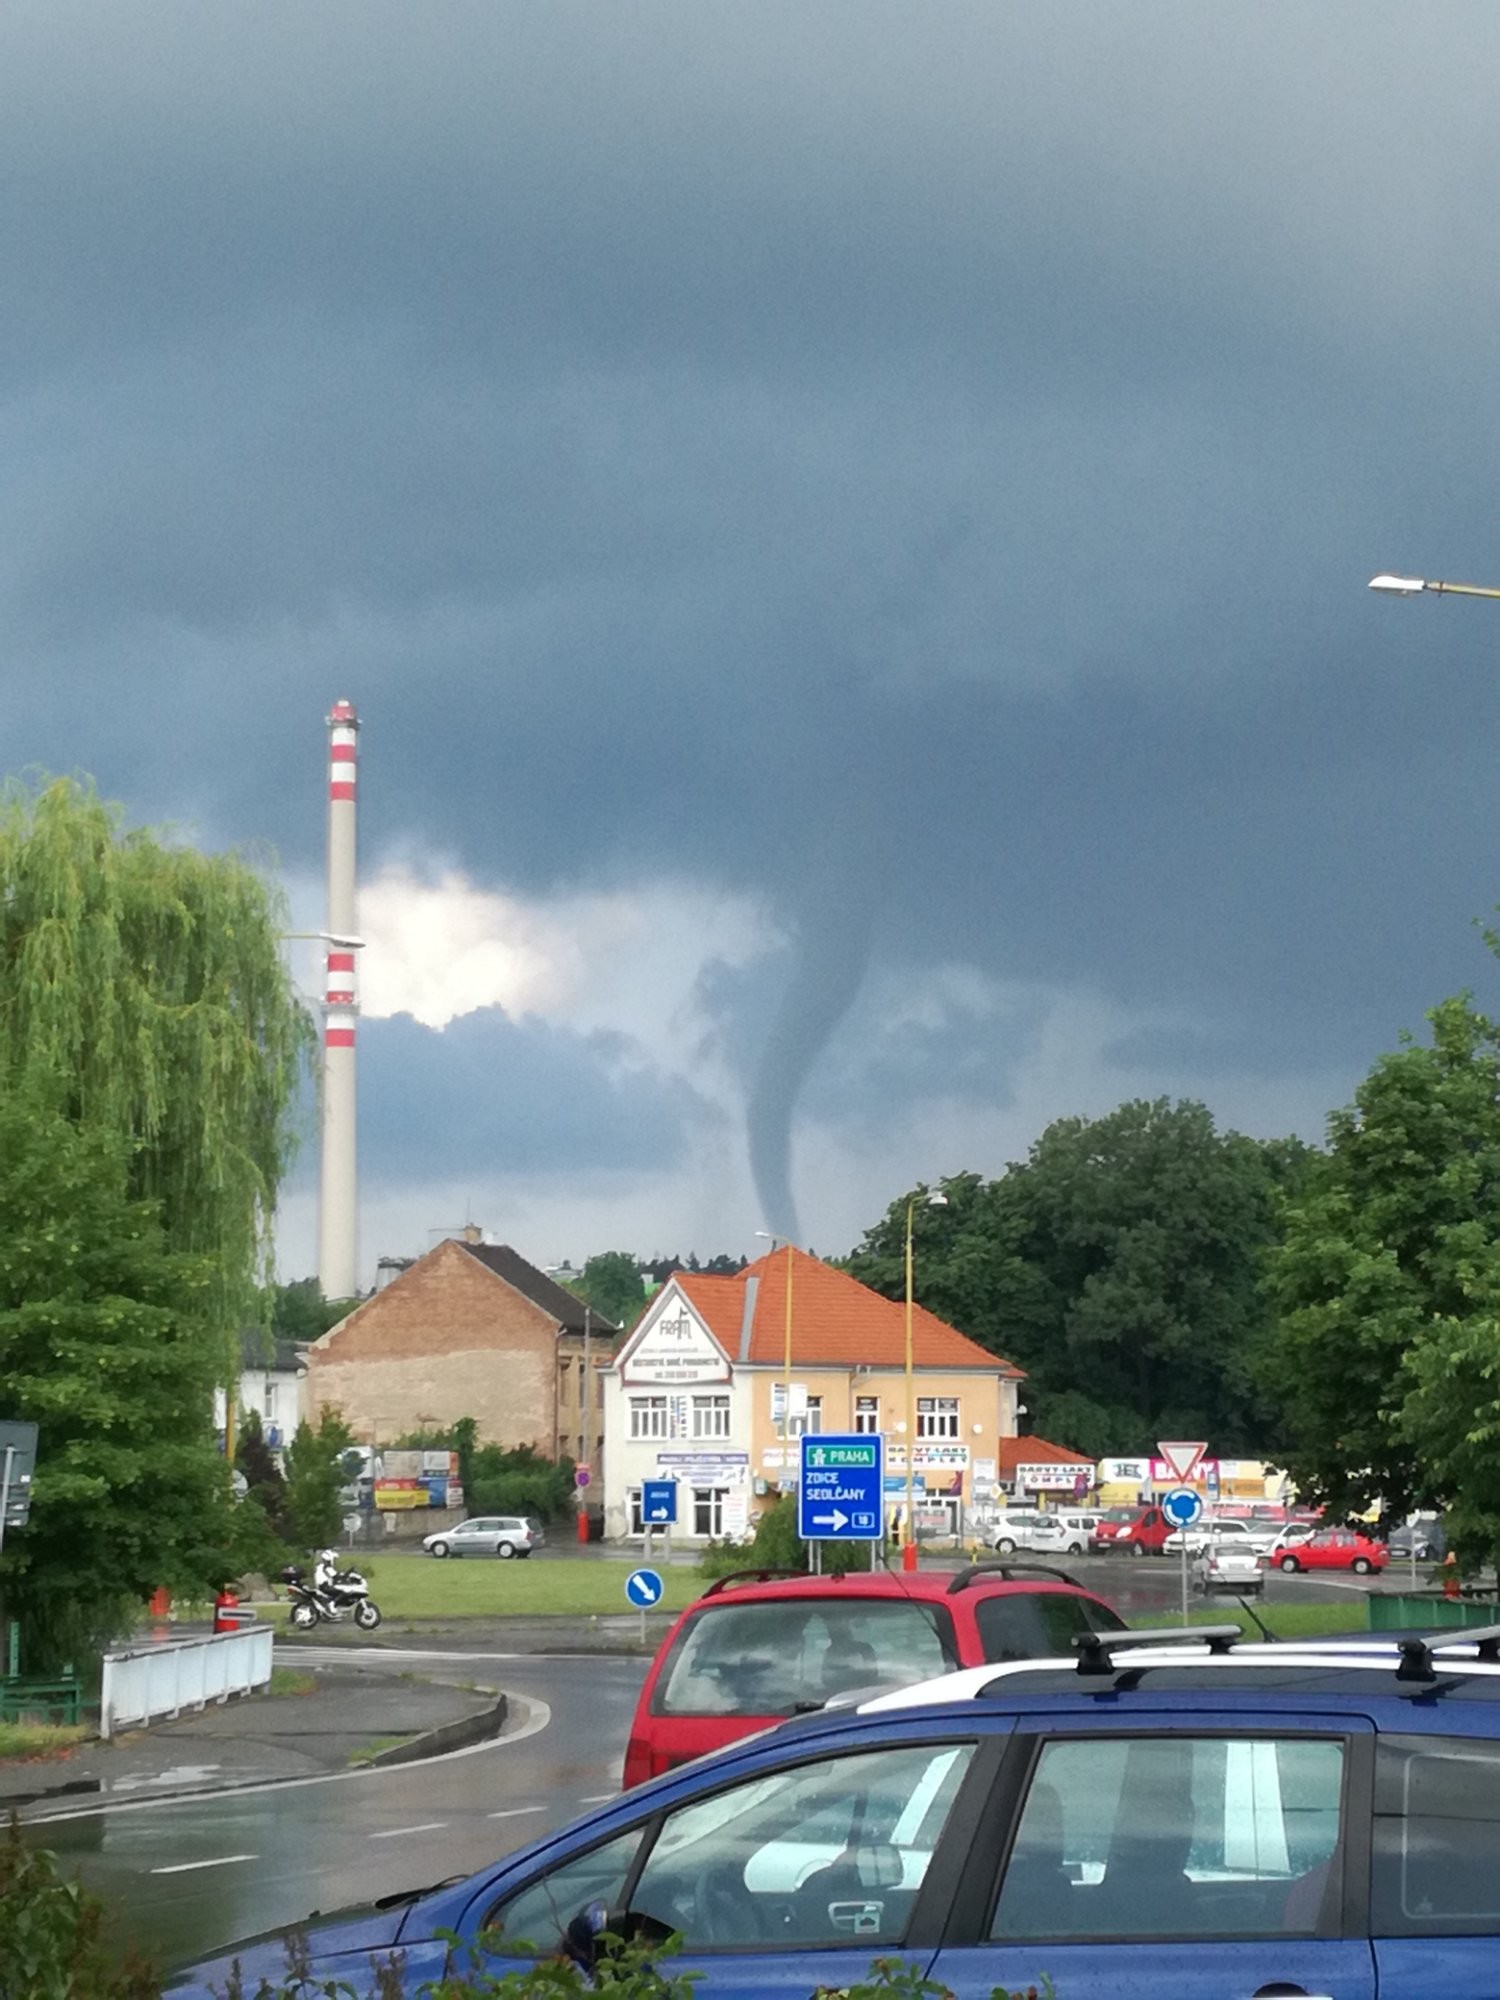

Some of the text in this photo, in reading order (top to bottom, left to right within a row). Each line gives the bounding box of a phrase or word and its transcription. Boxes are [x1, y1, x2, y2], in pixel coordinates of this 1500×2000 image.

[830, 1451, 870, 1462] PRAHA
[1154, 1461, 1217, 1480] BAVY
[805, 1472, 839, 1485] ZDICE
[806, 1486, 865, 1500] SEDLČANY
